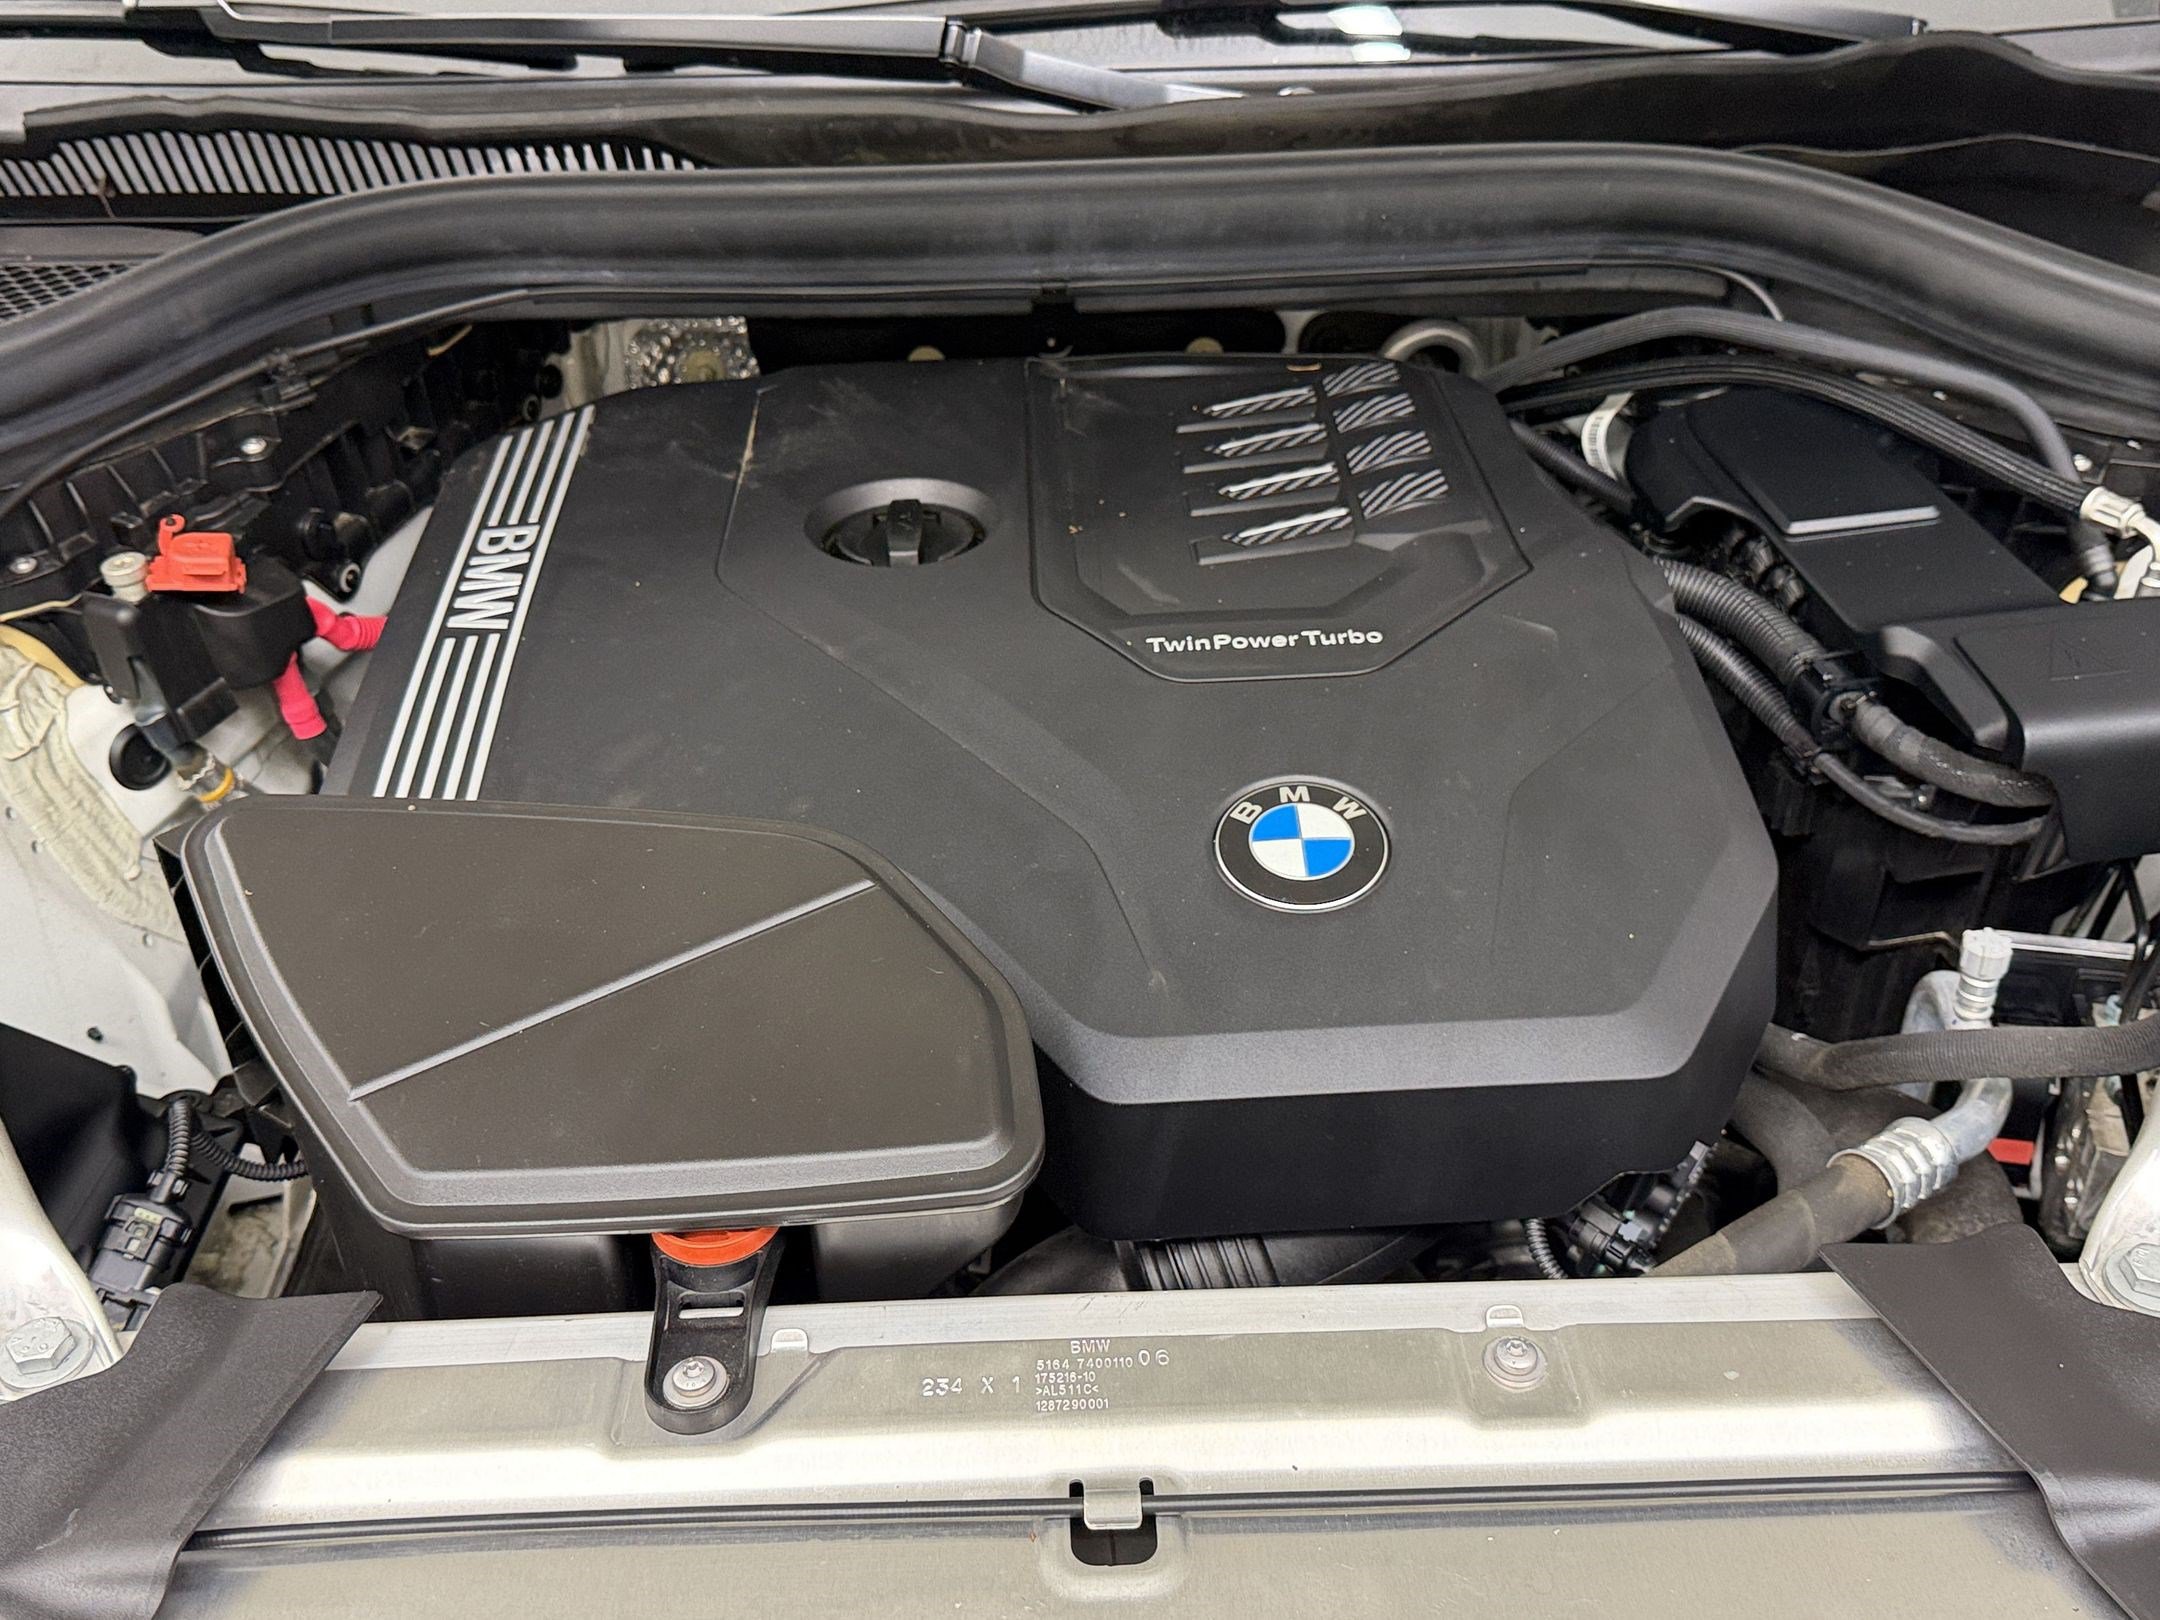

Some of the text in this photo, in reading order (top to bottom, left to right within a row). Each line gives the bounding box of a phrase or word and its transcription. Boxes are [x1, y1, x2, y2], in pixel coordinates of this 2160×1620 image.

[446, 524, 541, 630] BMW
[1229, 785, 1368, 825] BMW
[1070, 1339, 1111, 1354] BMW
[1036, 1357, 1133, 1371] 5164 7400110
[1034, 1372, 1096, 1384] 175216-10
[921, 1375, 1022, 1398] 234 X 1
[1035, 1398, 1109, 1412] 1287290001
